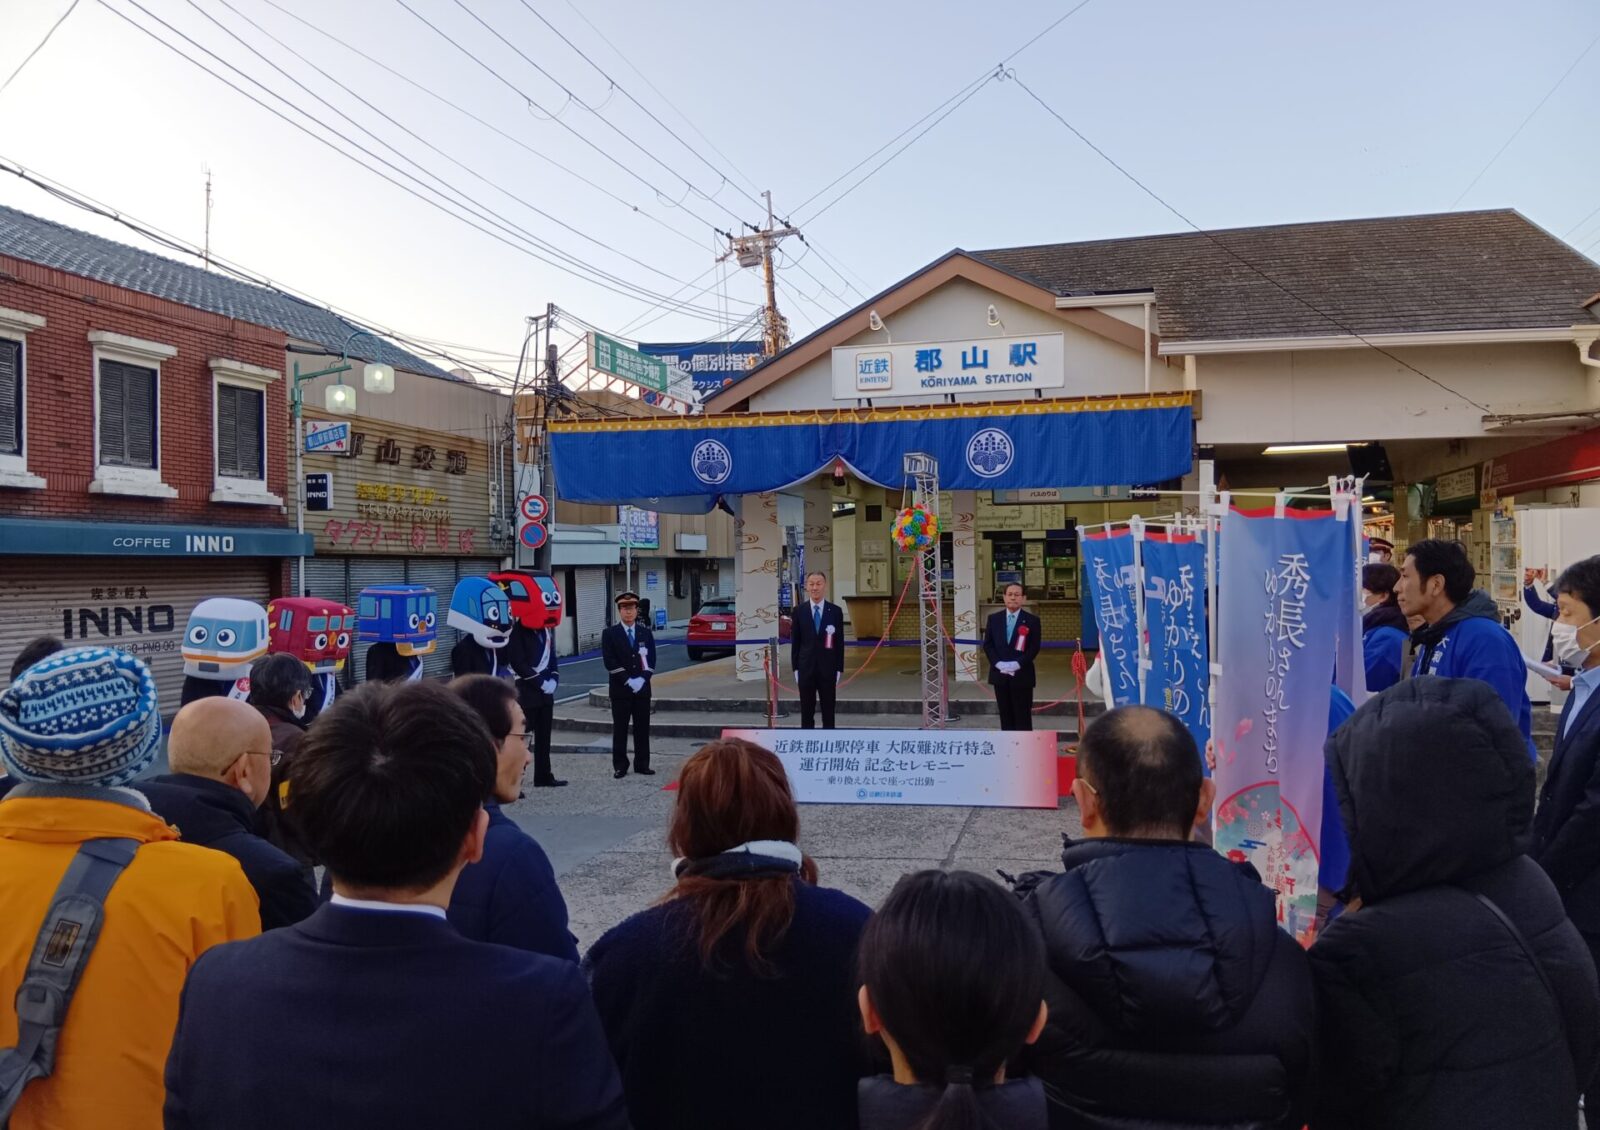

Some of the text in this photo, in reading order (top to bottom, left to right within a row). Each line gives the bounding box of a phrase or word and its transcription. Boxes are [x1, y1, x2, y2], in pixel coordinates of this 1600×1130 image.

[651, 353, 764, 374] 間の個別指
[914, 342, 1038, 373] 郡山駅
[858, 359, 889, 375] 近鉄
[859, 375, 889, 385] KINTETSU
[984, 372, 1033, 385] STATION
[307, 491, 328, 499] INNO
[112, 535, 235, 553] COFFEE INNO
[62, 604, 175, 640] INNO
[1277, 553, 1311, 711] 秀長さん
[1164, 579, 1192, 727] ゆかりの
[775, 739, 996, 756] 近鉄郡山駅停車 大阪難波行特急
[799, 756, 966, 773] 運行開始 記念セレモニー
